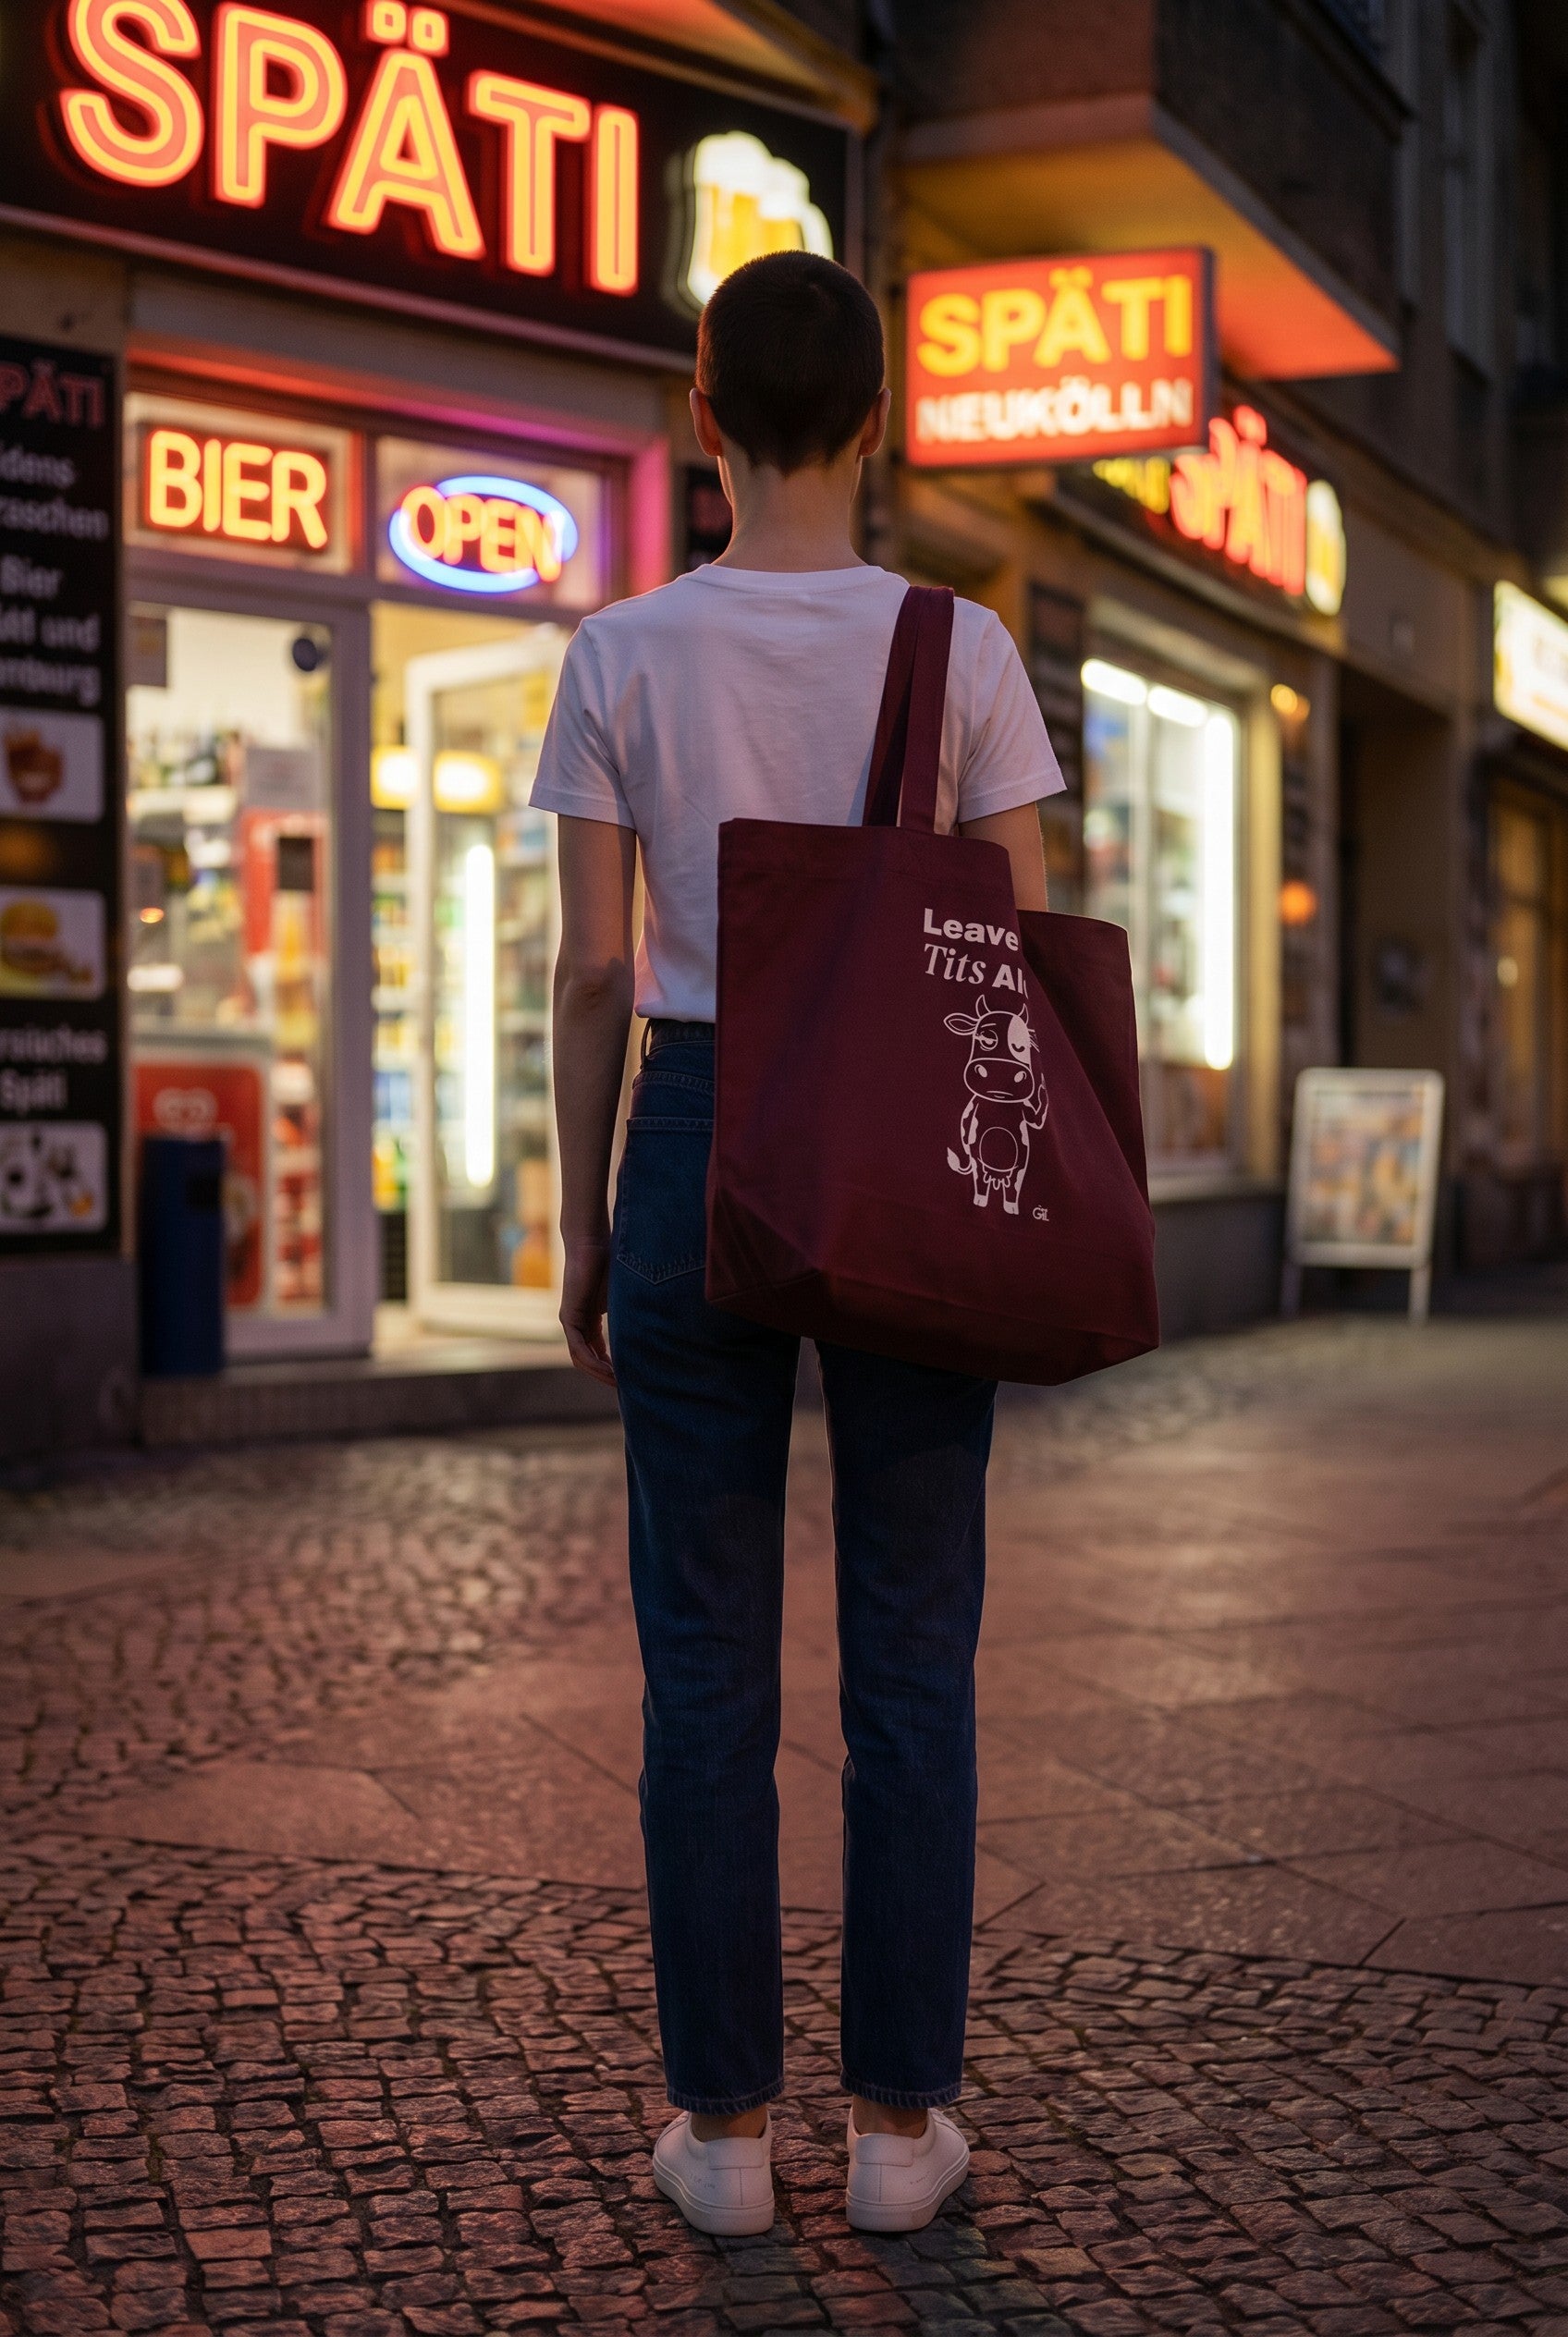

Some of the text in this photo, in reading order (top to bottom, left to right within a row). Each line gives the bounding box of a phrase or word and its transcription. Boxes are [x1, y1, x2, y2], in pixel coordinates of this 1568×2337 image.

[60, 0, 639, 296] SPÄTI
[916, 265, 1194, 377] SPÄTI
[915, 374, 1194, 445] NEUKÖLLN
[148, 429, 328, 550] BIER
[399, 483, 563, 583] OPEN
[2, 556, 62, 600] Bier
[924, 908, 1019, 951] Leave
[925, 943, 1028, 999] Tits Al
